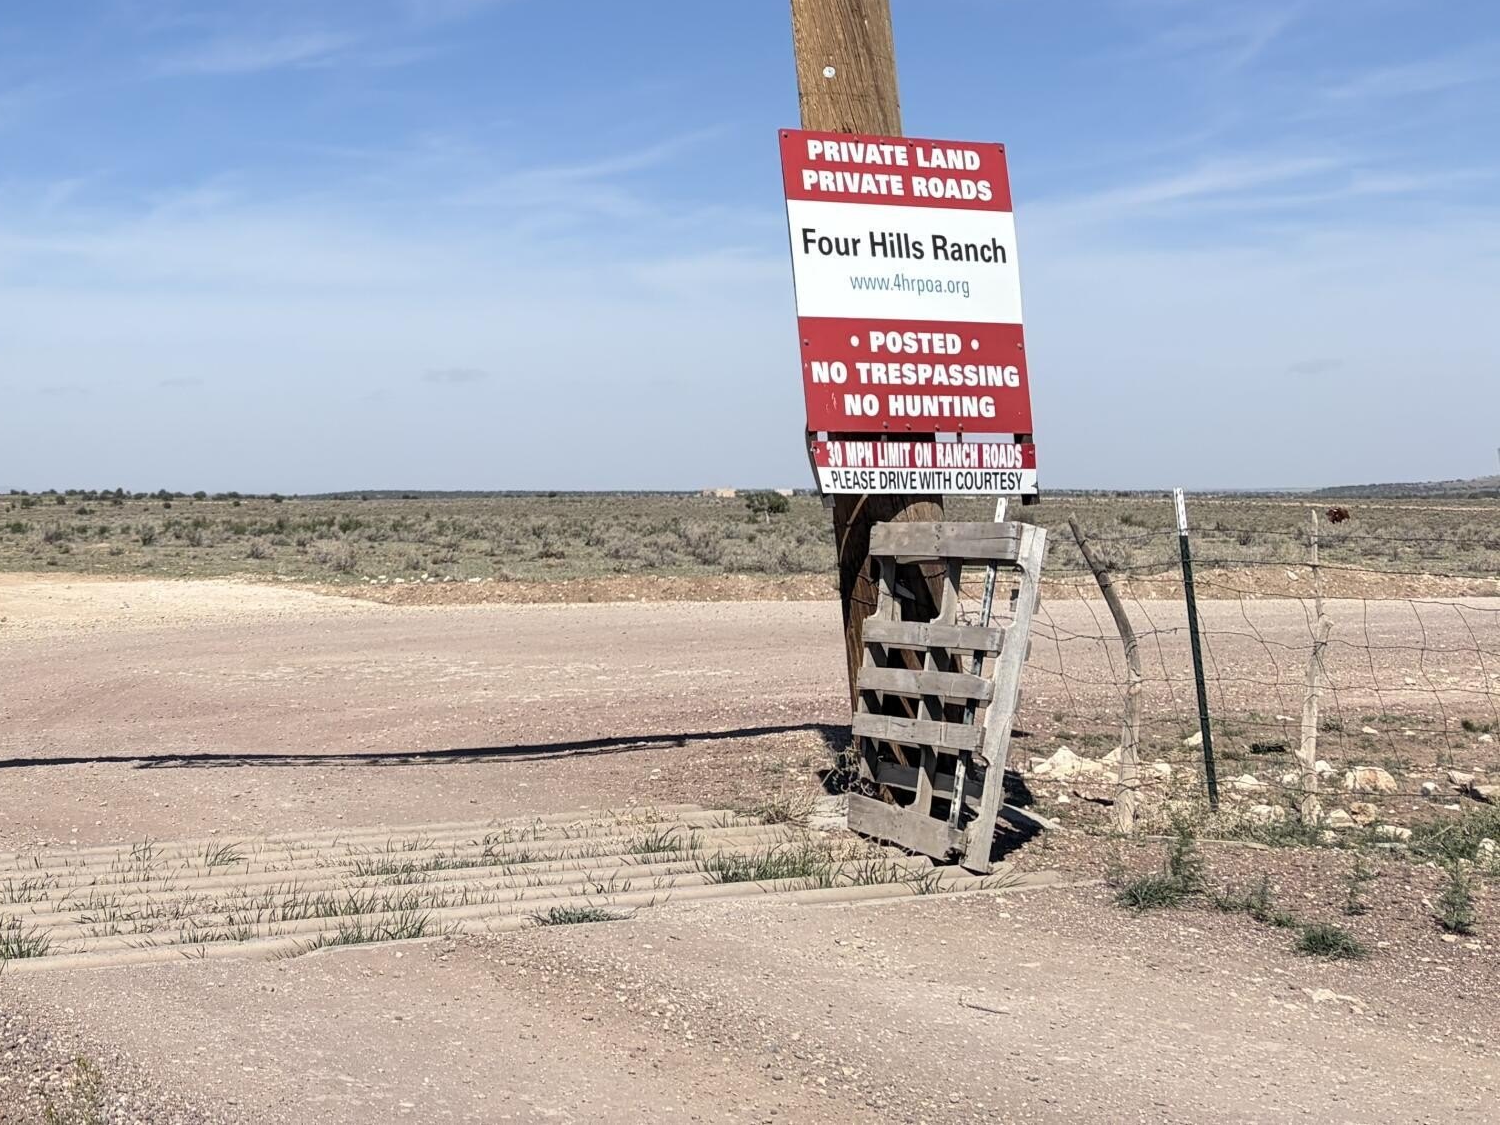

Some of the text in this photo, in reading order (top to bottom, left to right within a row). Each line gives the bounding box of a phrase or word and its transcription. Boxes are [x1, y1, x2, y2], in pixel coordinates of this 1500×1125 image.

[807, 139, 981, 172] PRIVATE LAND
[802, 169, 993, 202] PRIVATE ROADS
[802, 228, 1007, 264] Four Hills Ranch
[850, 273, 970, 298] www.4hrpoa.org
[869, 331, 962, 355] POSTED
[811, 361, 1020, 387] NO TRESPASSING
[844, 394, 996, 418] NO HUNTING
[826, 442, 1023, 469] 30 MPH LIMIT ON RANCH ROADS
[831, 470, 1023, 491] PLEASE DRIVE WITH COURTESY
